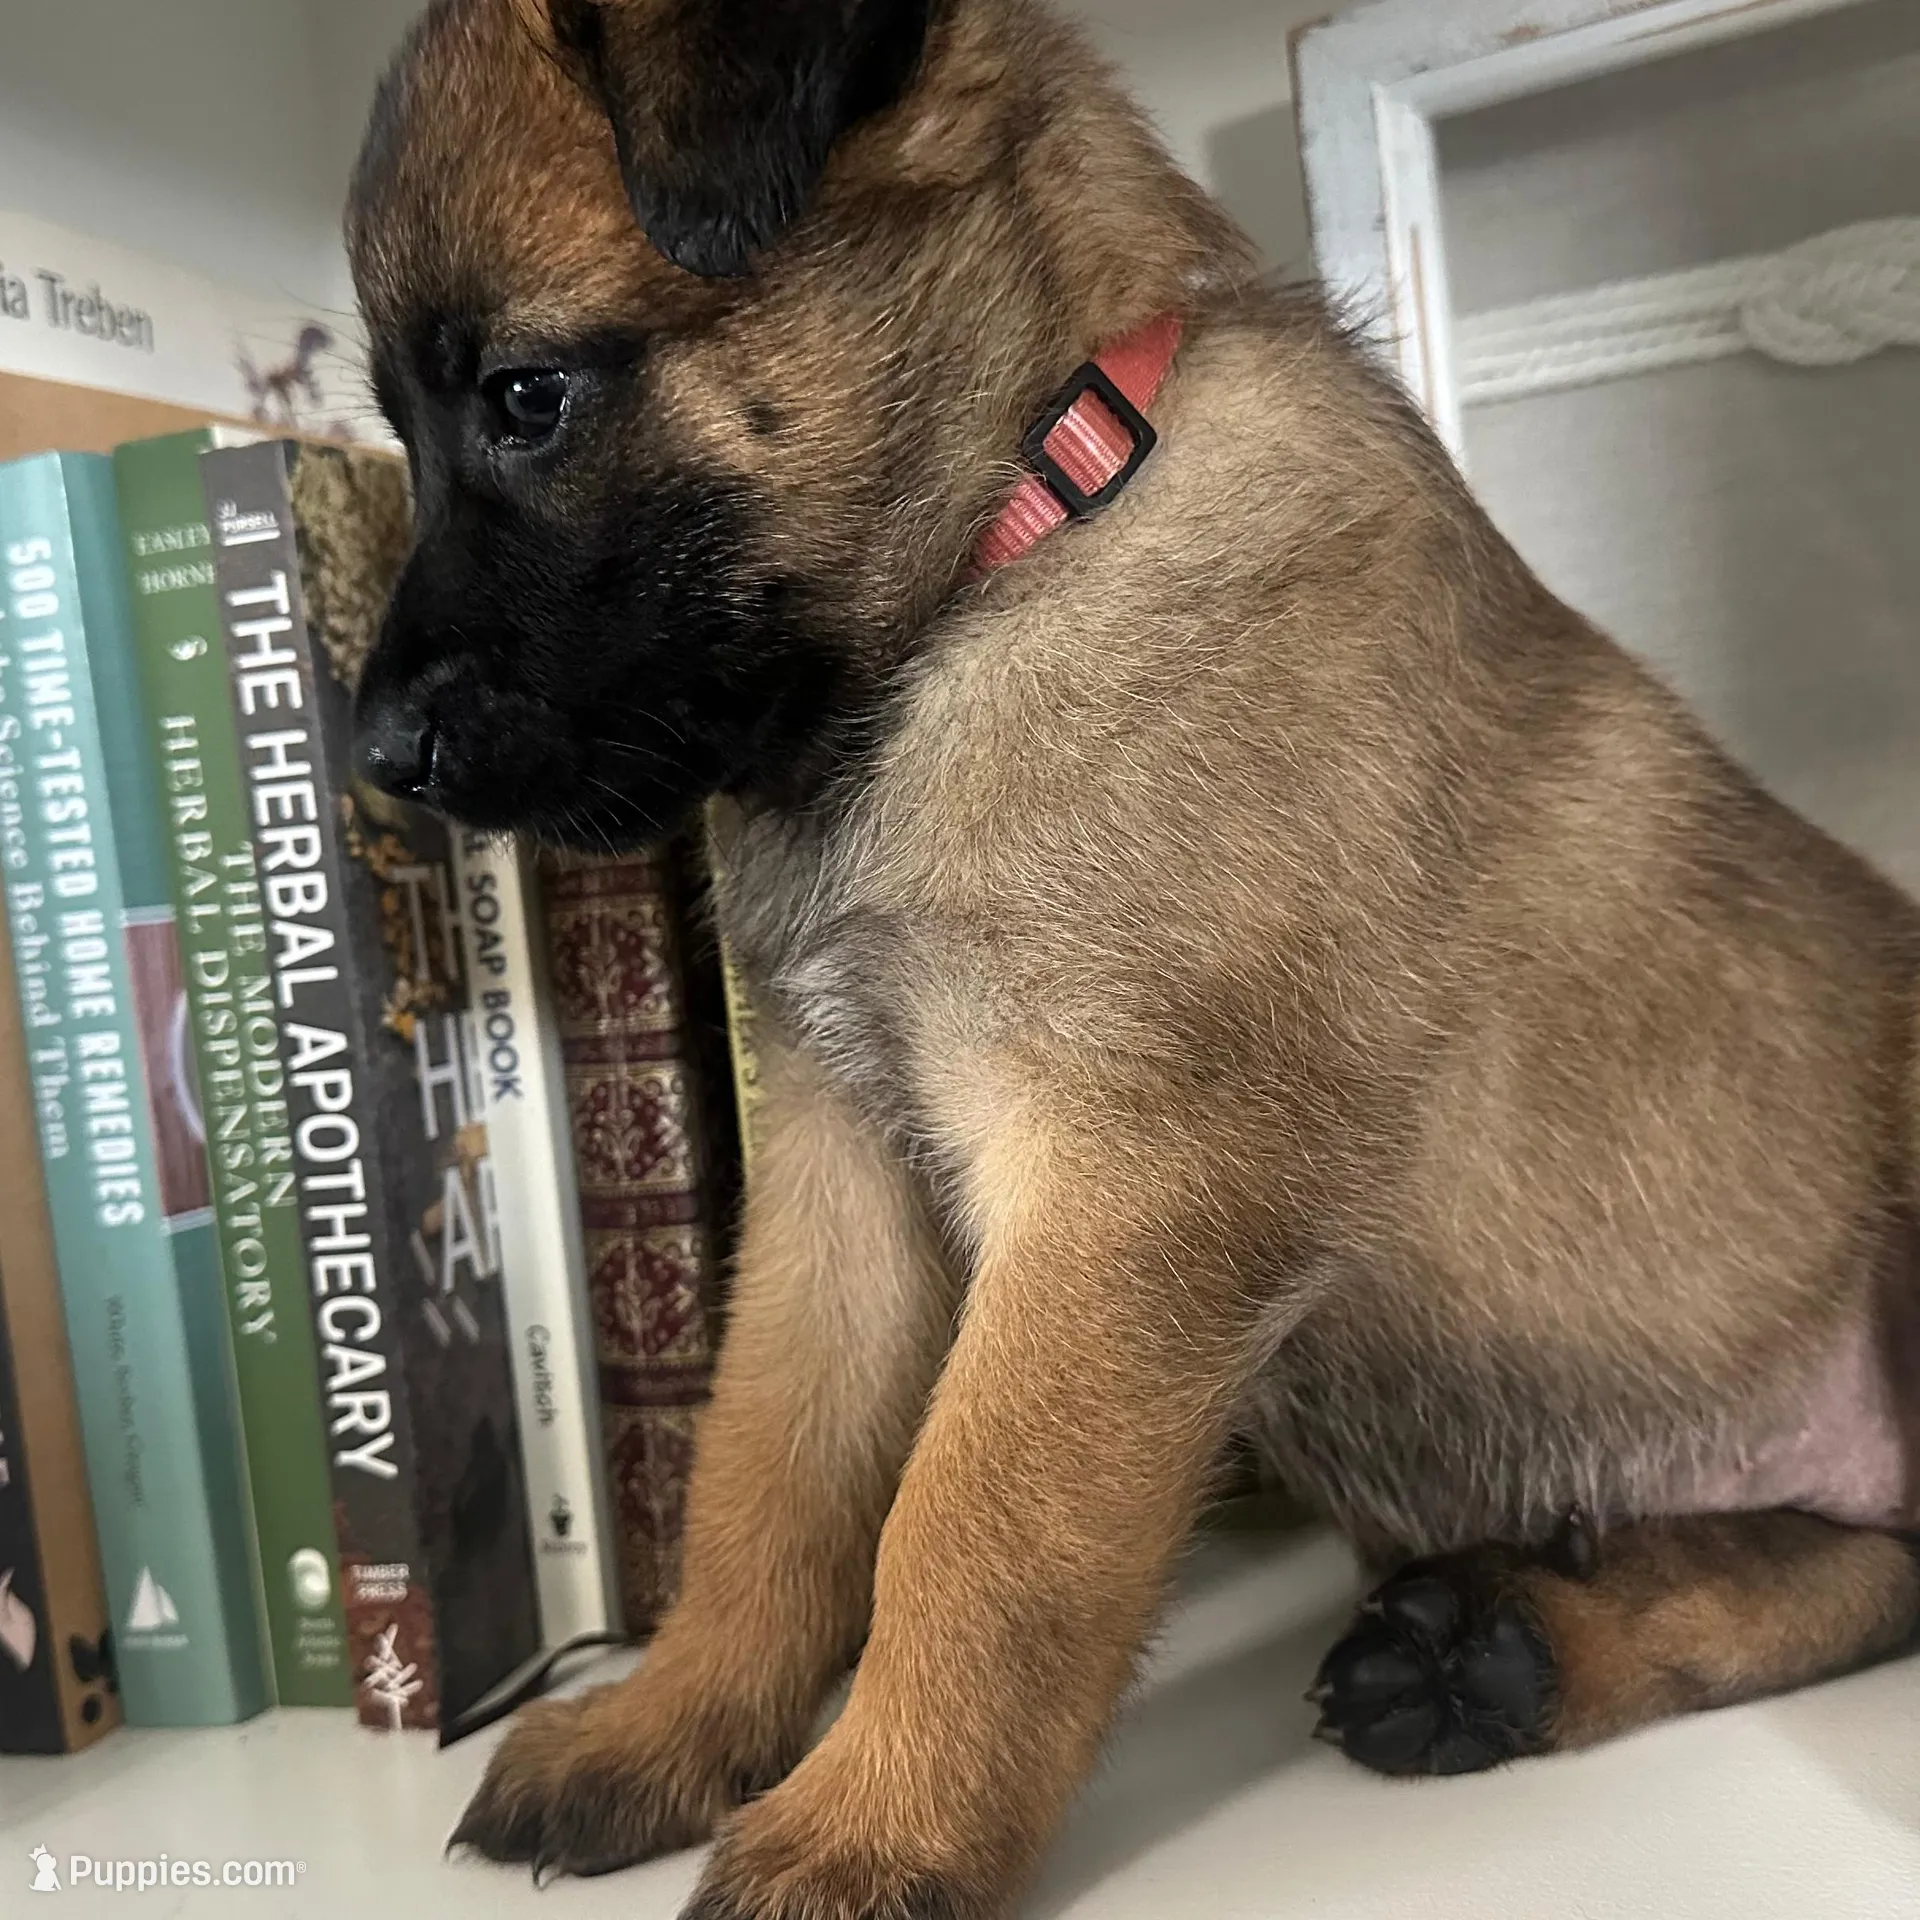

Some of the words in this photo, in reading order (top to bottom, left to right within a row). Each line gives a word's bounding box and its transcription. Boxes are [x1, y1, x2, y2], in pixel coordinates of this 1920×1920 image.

[34, 266, 155, 354] Treben
[6, 537, 59, 619] 500
[225, 569, 303, 716] THE
[20, 627, 98, 897] TIME-TESTED
[218, 840, 267, 957] THE
[246, 729, 339, 1008] HERBAL
[467, 874, 507, 976] SOAP
[9, 881, 62, 1027] Behind
[57, 910, 117, 1019] HOME
[31, 1035, 70, 1160] Them
[158, 715, 222, 935] HERBAL
[190, 950, 277, 1344] DISPENSATORY
[238, 974, 297, 1207] MODERN
[482, 987, 524, 1101] BOOK
[76, 1030, 144, 1227] REMEDIES
[283, 1021, 400, 1480] APOTHECARY
